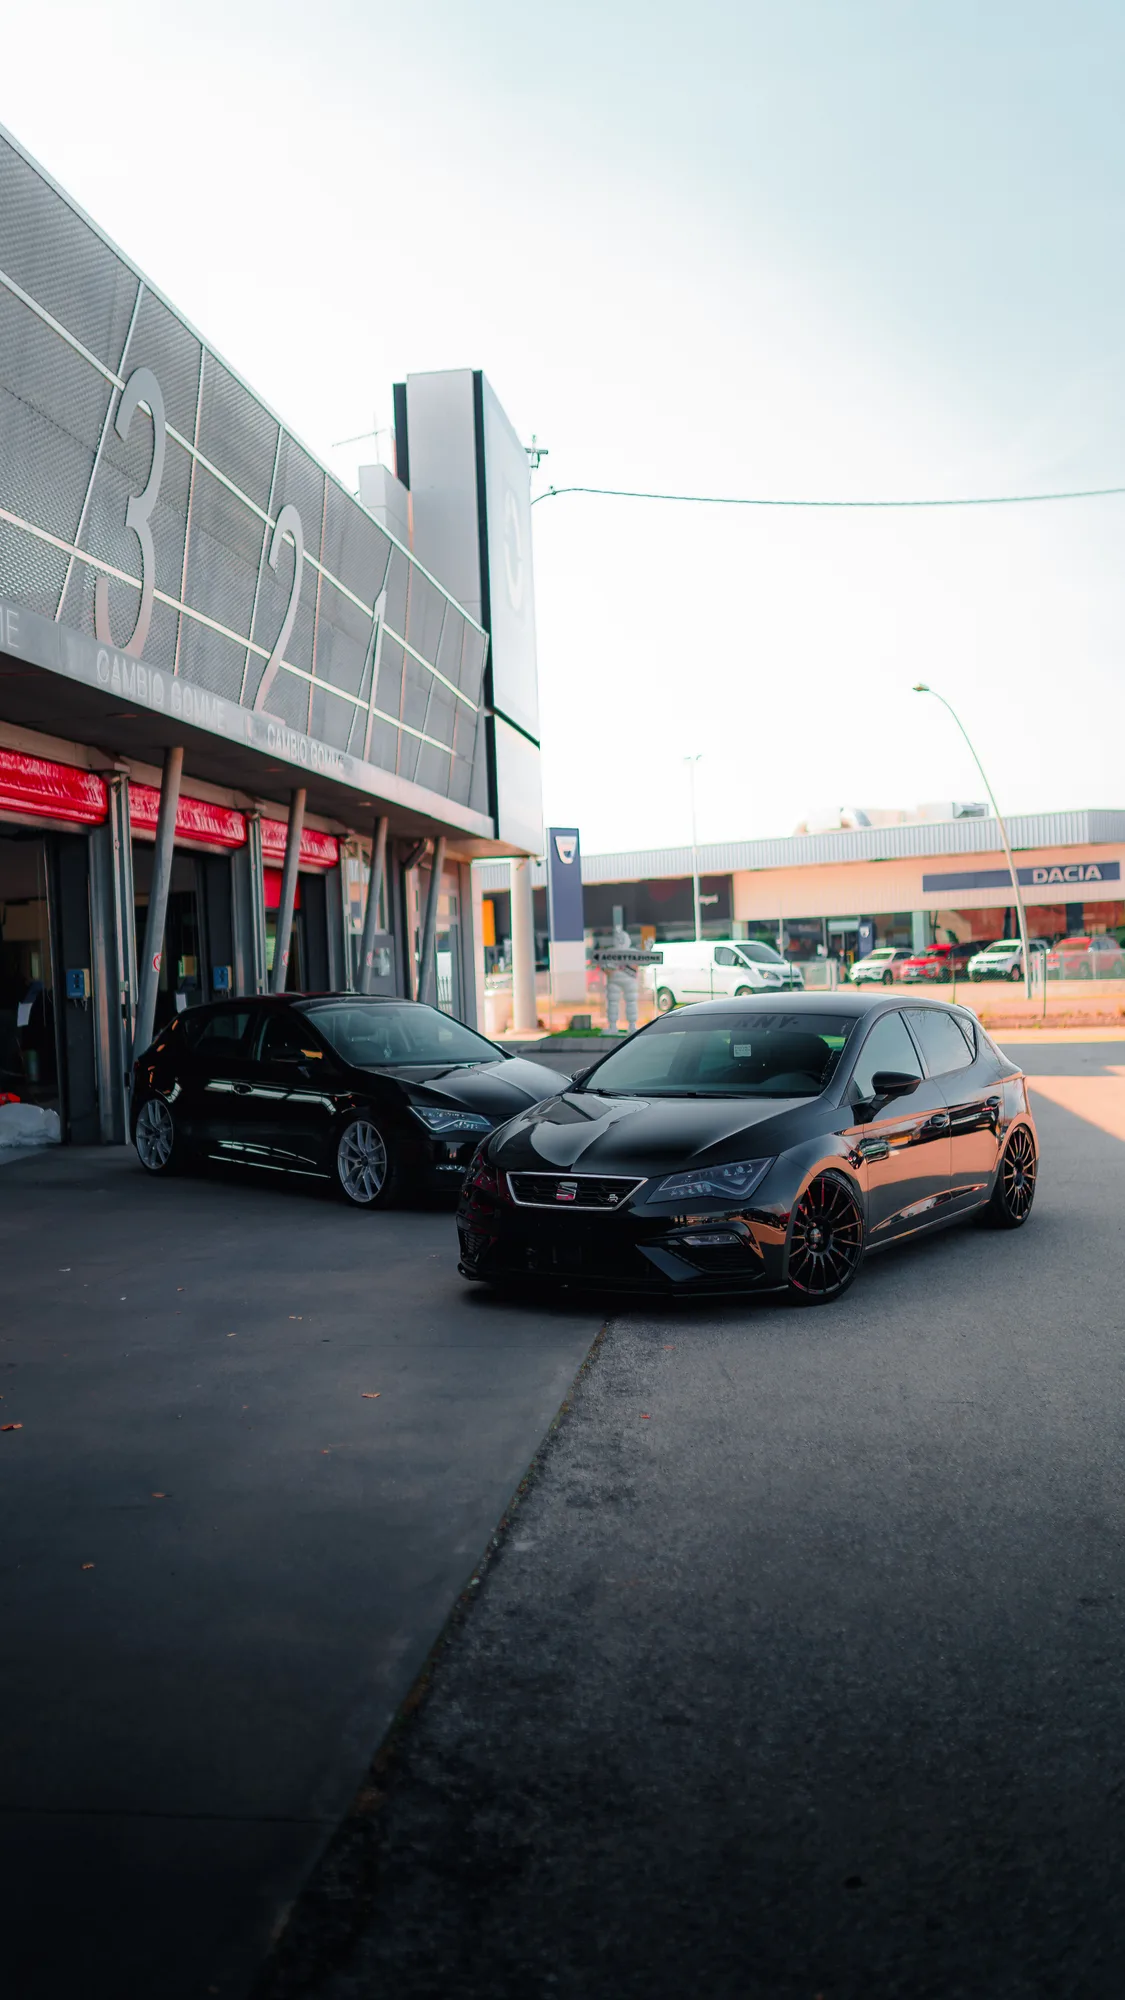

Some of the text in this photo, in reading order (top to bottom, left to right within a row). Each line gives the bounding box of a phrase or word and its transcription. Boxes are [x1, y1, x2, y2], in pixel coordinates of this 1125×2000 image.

[94, 367, 165, 658] 3
[253, 504, 304, 725] 2
[96, 648, 225, 730] CAMBIO GOMME
[267, 723, 307, 766] CAMBIO
[1032, 864, 1103, 884] DACIA
[601, 953, 660, 961] ACCETTAZIONE
